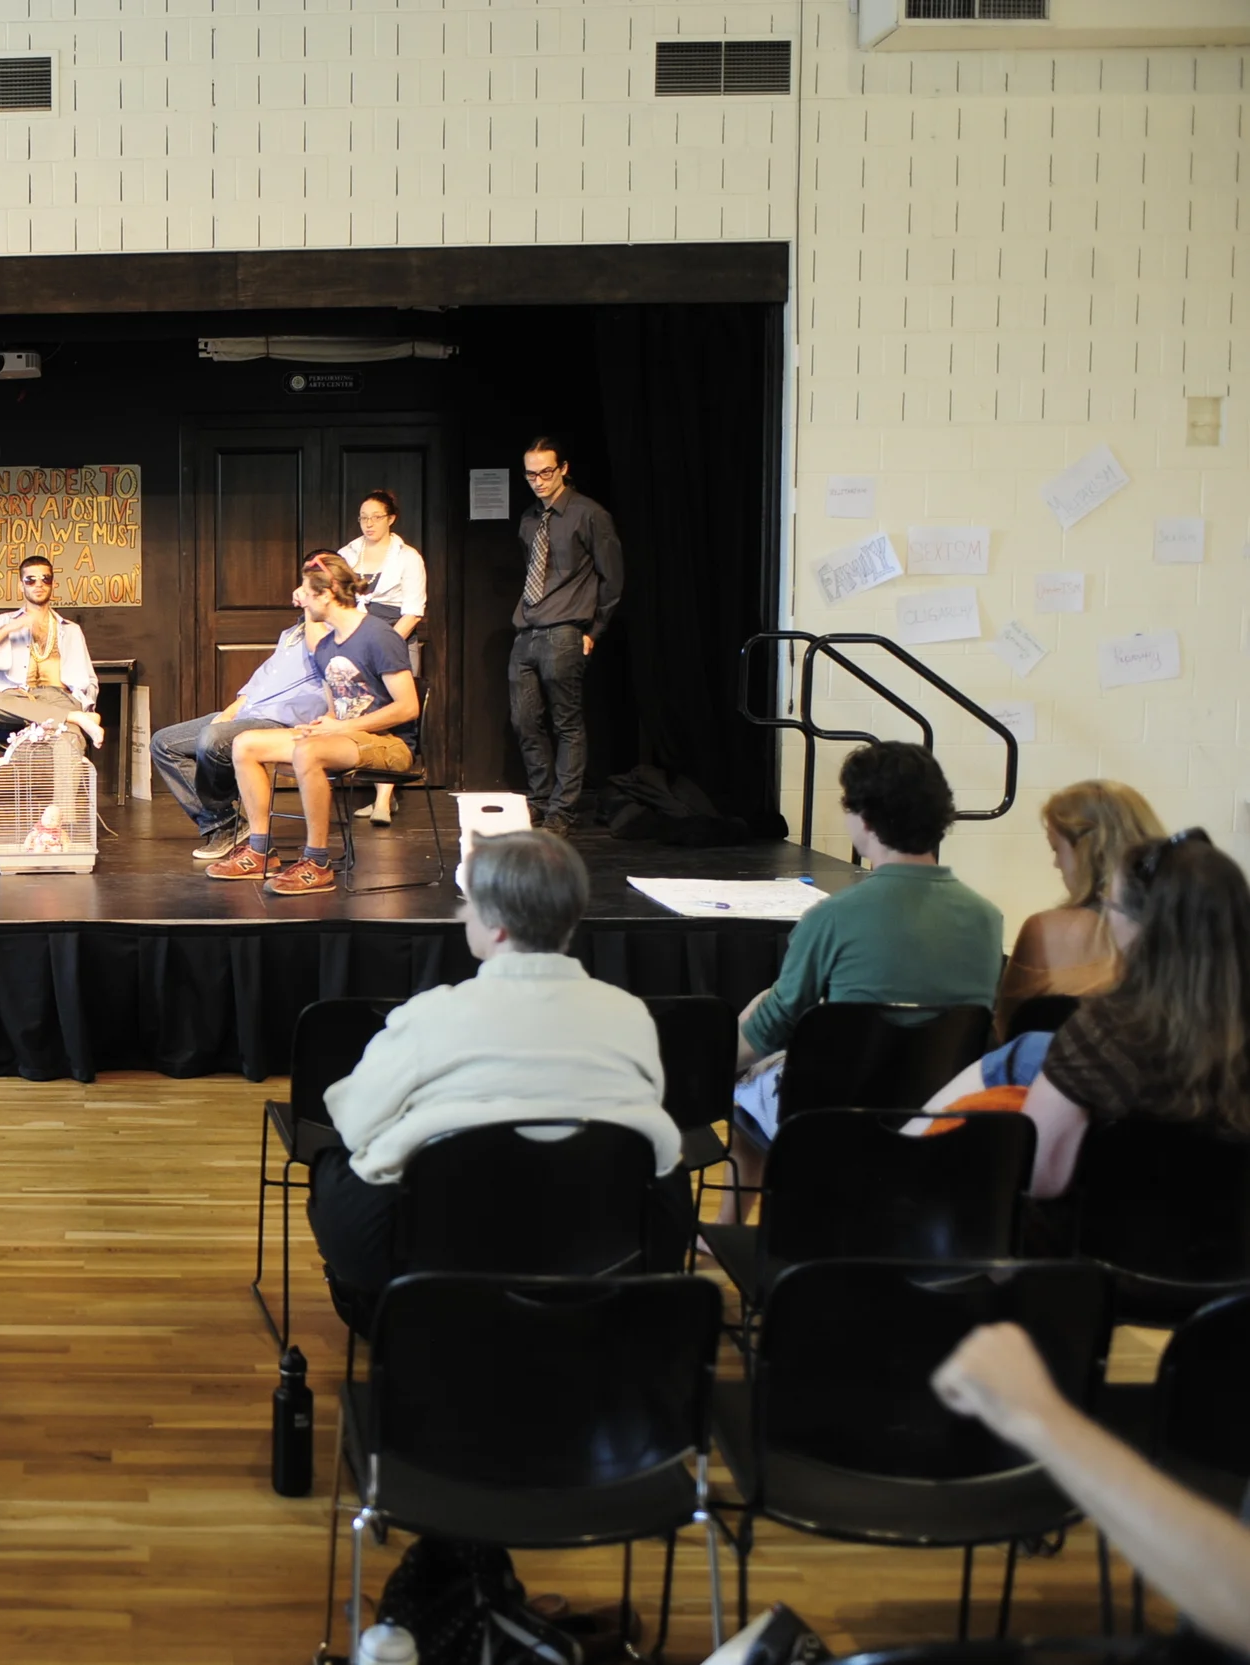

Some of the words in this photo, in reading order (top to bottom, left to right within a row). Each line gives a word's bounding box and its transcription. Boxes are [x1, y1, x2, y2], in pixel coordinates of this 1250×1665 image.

[16, 467, 99, 496] ORDER
[100, 466, 139, 499] TO
[40, 496, 60, 520] A
[62, 495, 139, 525] POSITIVE
[49, 521, 90, 545] WE
[92, 522, 140, 549] MUST
[74, 545, 96, 572] A
